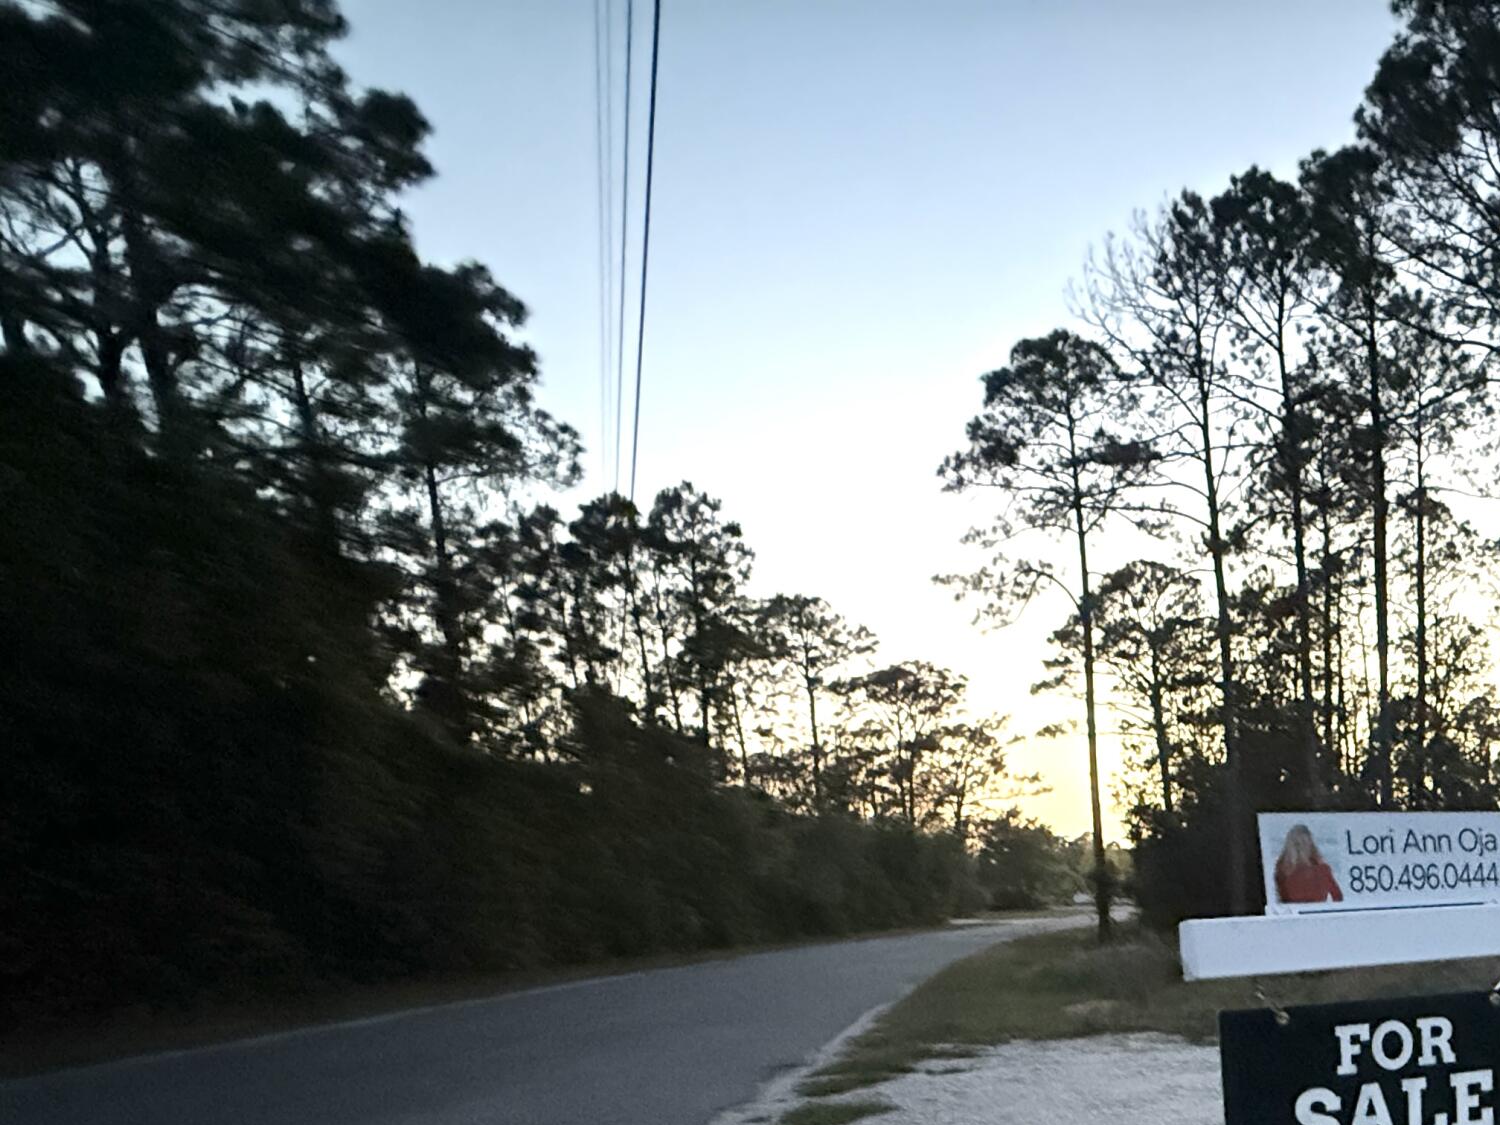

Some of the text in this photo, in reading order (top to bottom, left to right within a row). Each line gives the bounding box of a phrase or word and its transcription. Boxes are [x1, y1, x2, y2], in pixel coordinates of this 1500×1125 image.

[1346, 827, 1498, 857] Lori Ann Oja
[1350, 862, 1499, 893] 850.496.0444
[1334, 1016, 1457, 1075] FOR
